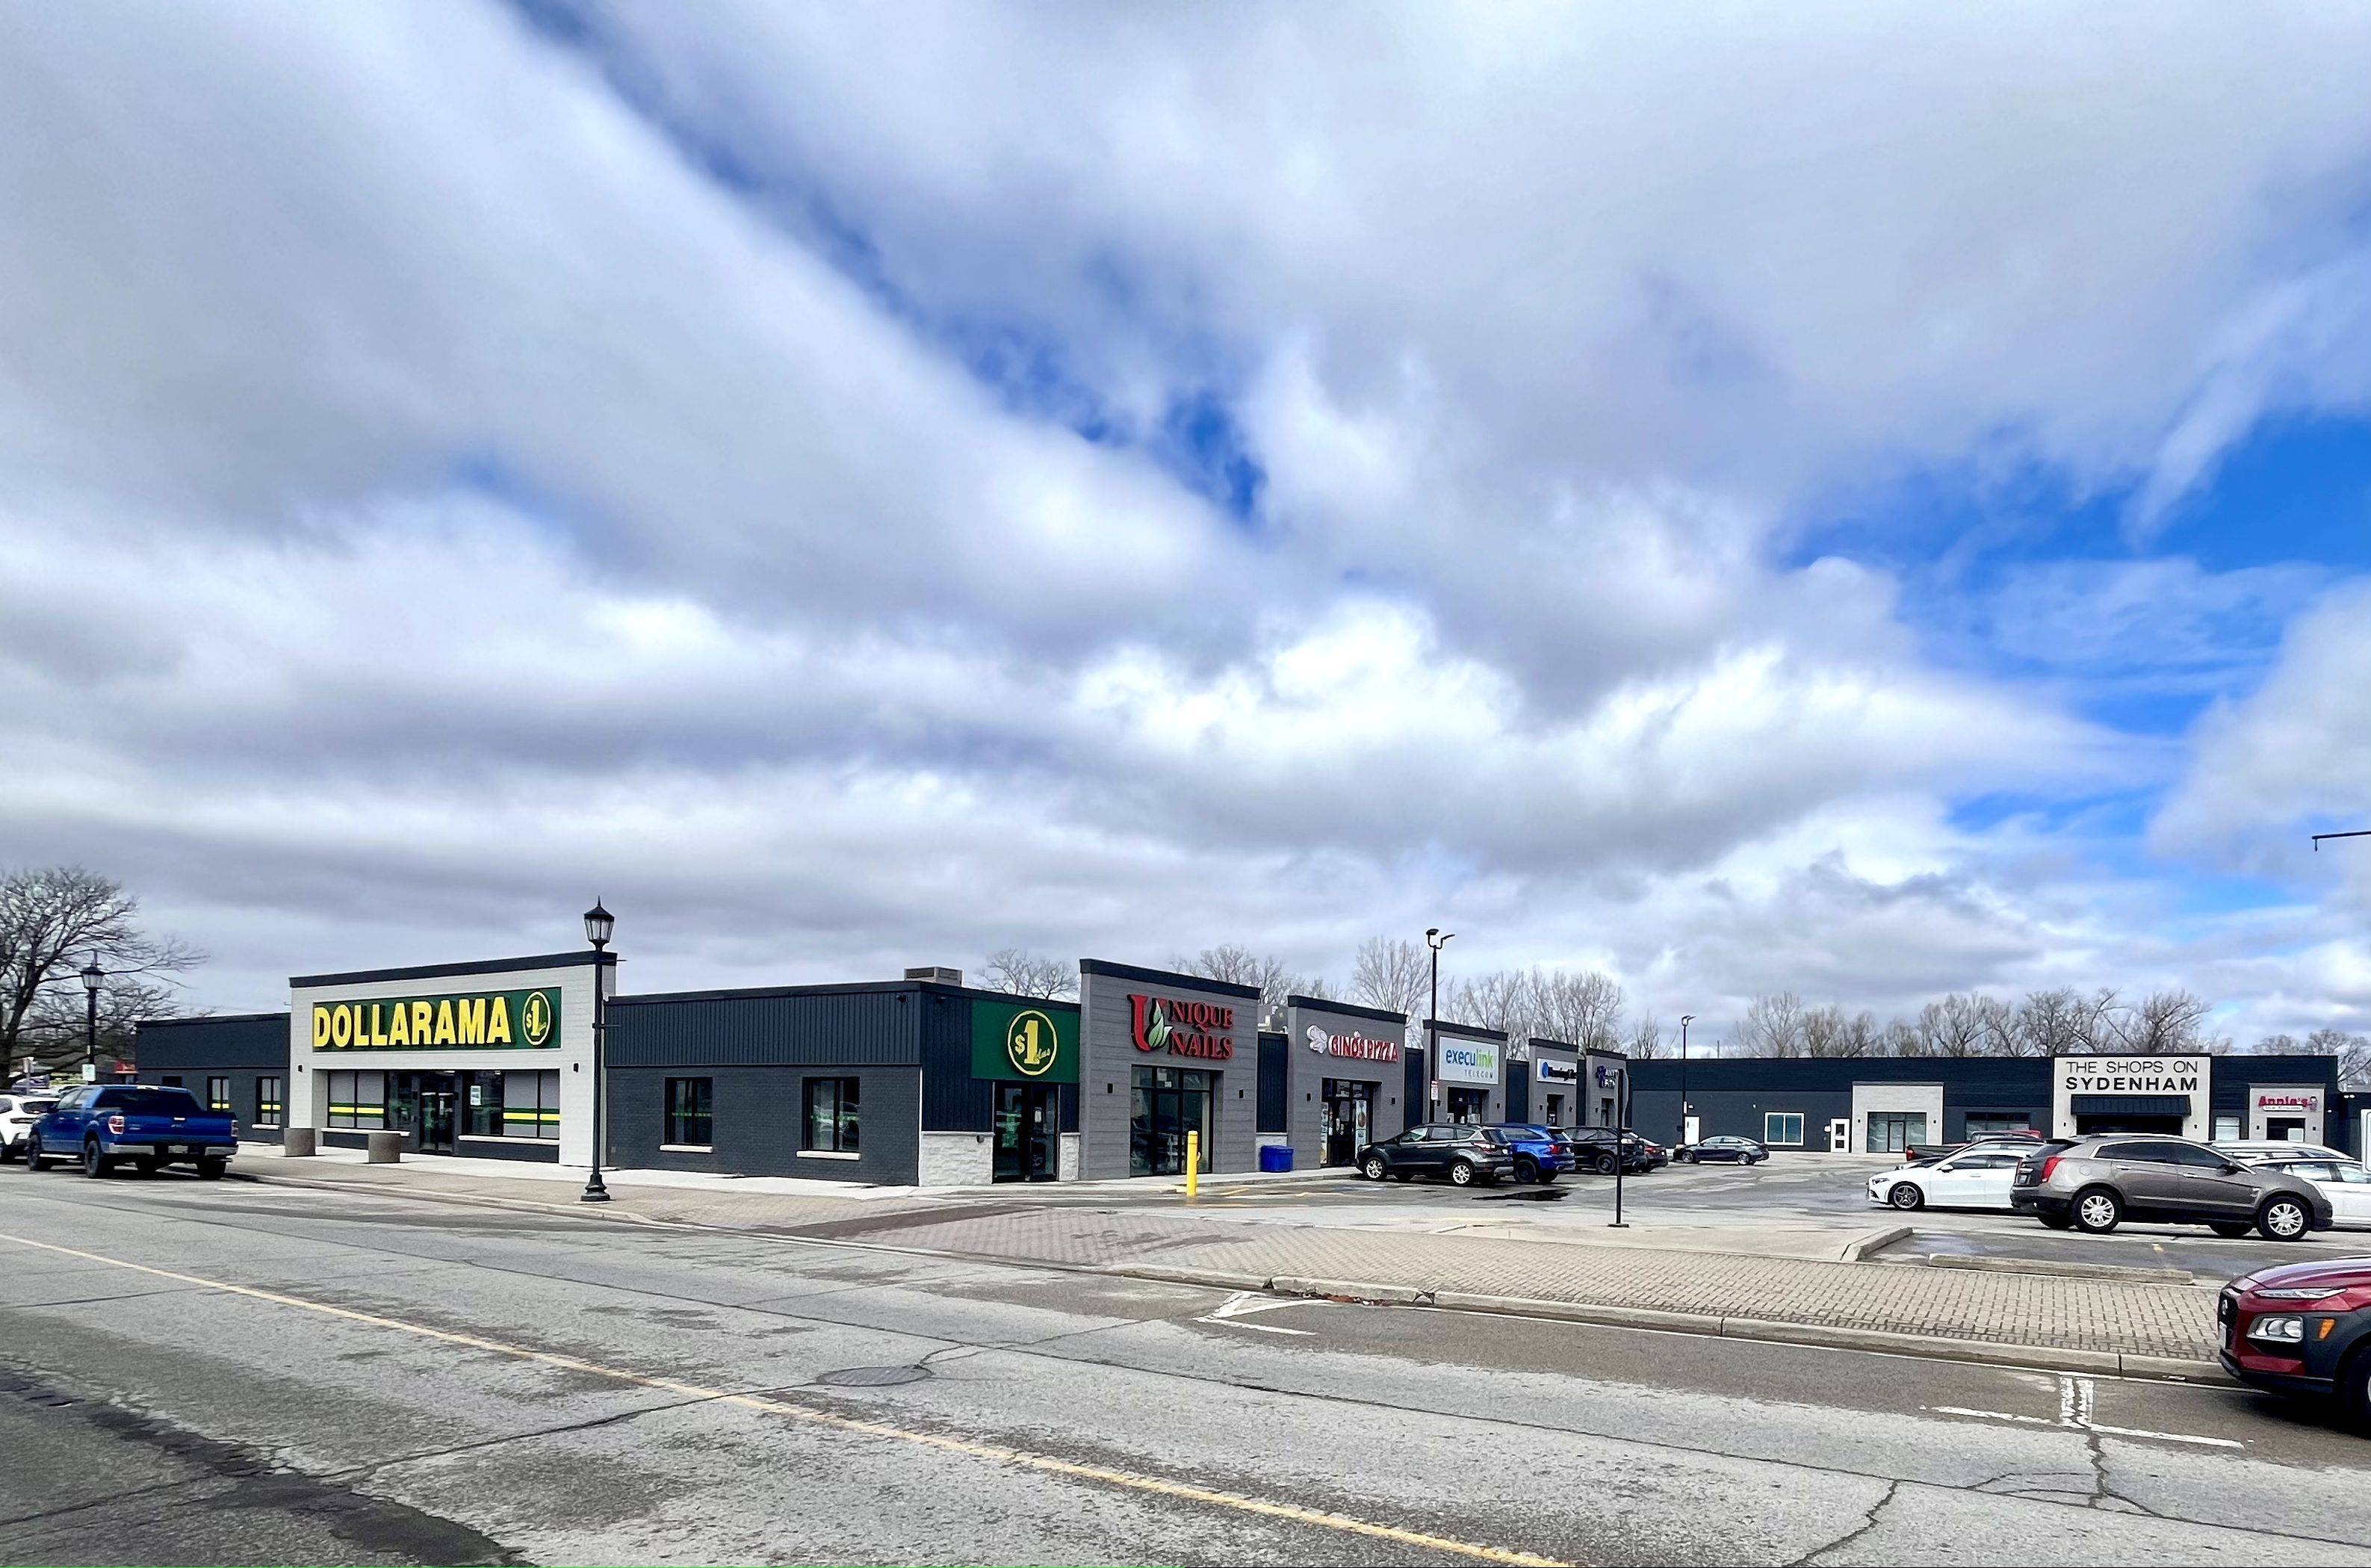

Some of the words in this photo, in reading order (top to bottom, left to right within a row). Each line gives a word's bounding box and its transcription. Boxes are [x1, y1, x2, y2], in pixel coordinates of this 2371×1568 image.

[313, 996, 512, 1047] DOLLARAMA
[1168, 1030, 1232, 1059] NAILS
[1445, 1047, 1493, 1069] execulink
[2065, 1061, 2098, 1073] THE
[2106, 1060, 2164, 1073] SHOPS
[2173, 1060, 2198, 1073] ON
[2065, 1076, 2198, 1091] SYDENHAM
